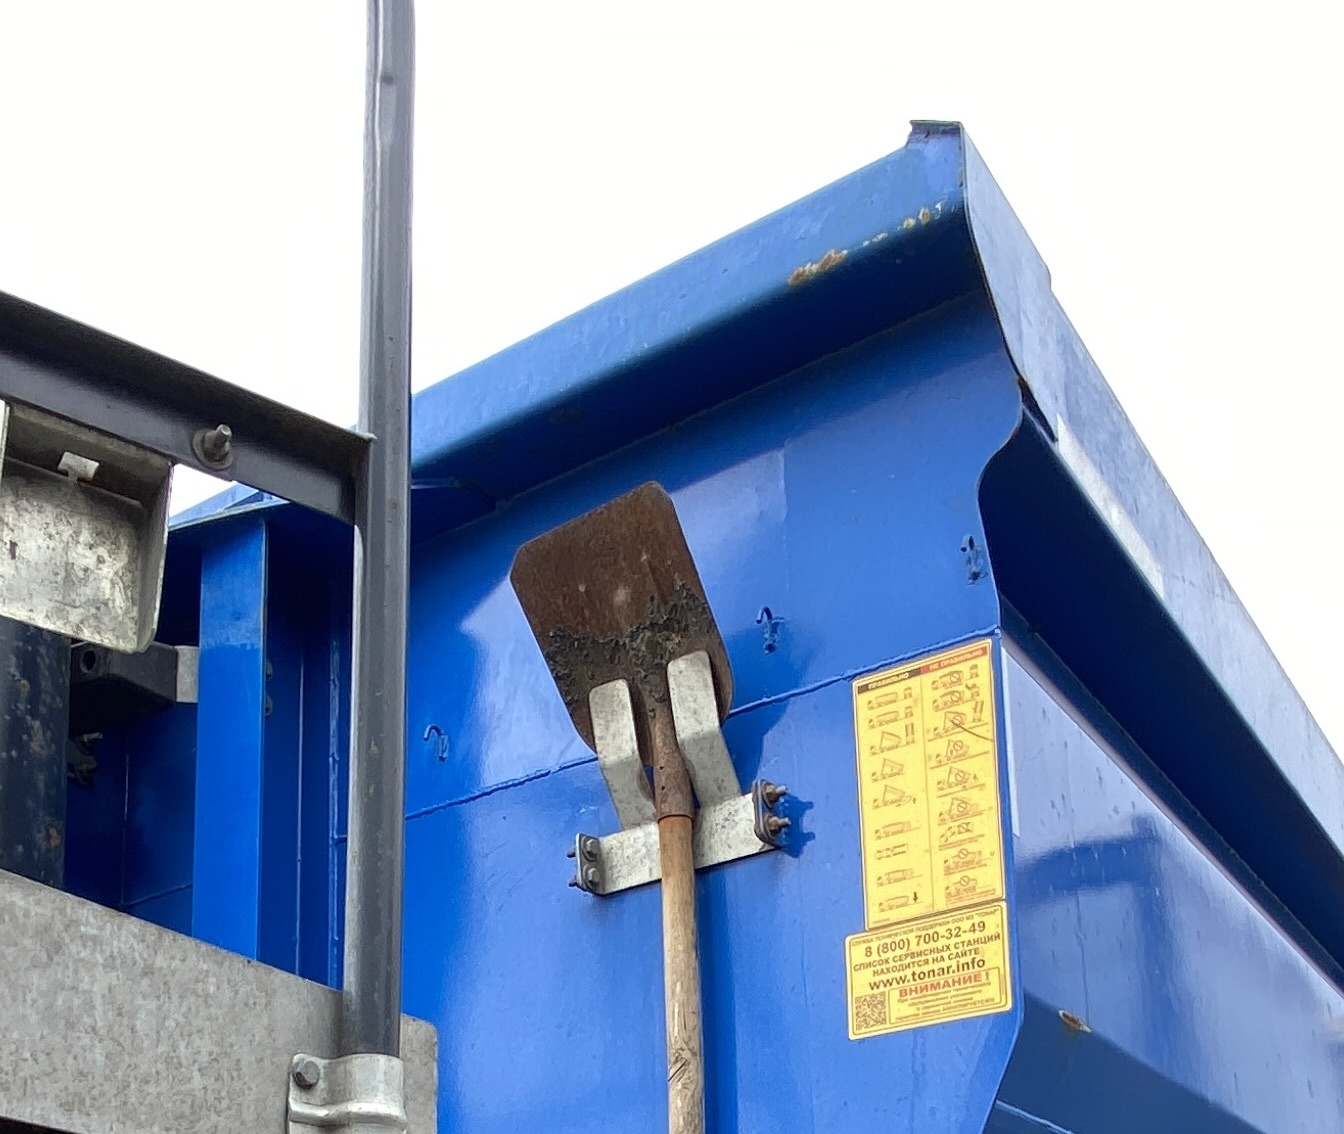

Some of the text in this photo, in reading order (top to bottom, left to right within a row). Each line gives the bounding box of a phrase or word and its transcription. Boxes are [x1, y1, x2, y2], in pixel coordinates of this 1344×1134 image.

[853, 931, 1001, 972] СПИСОК СЕРВИСНЫХ СТАНЦИЙ
[864, 920, 986, 958] 8 (800) 700-32-49
[869, 956, 986, 991] www.tonar.info
[872, 947, 981, 978] НАХОДИТСЯ НА САЙТЕ
[899, 973, 983, 999] ВНИМАНИЕ
